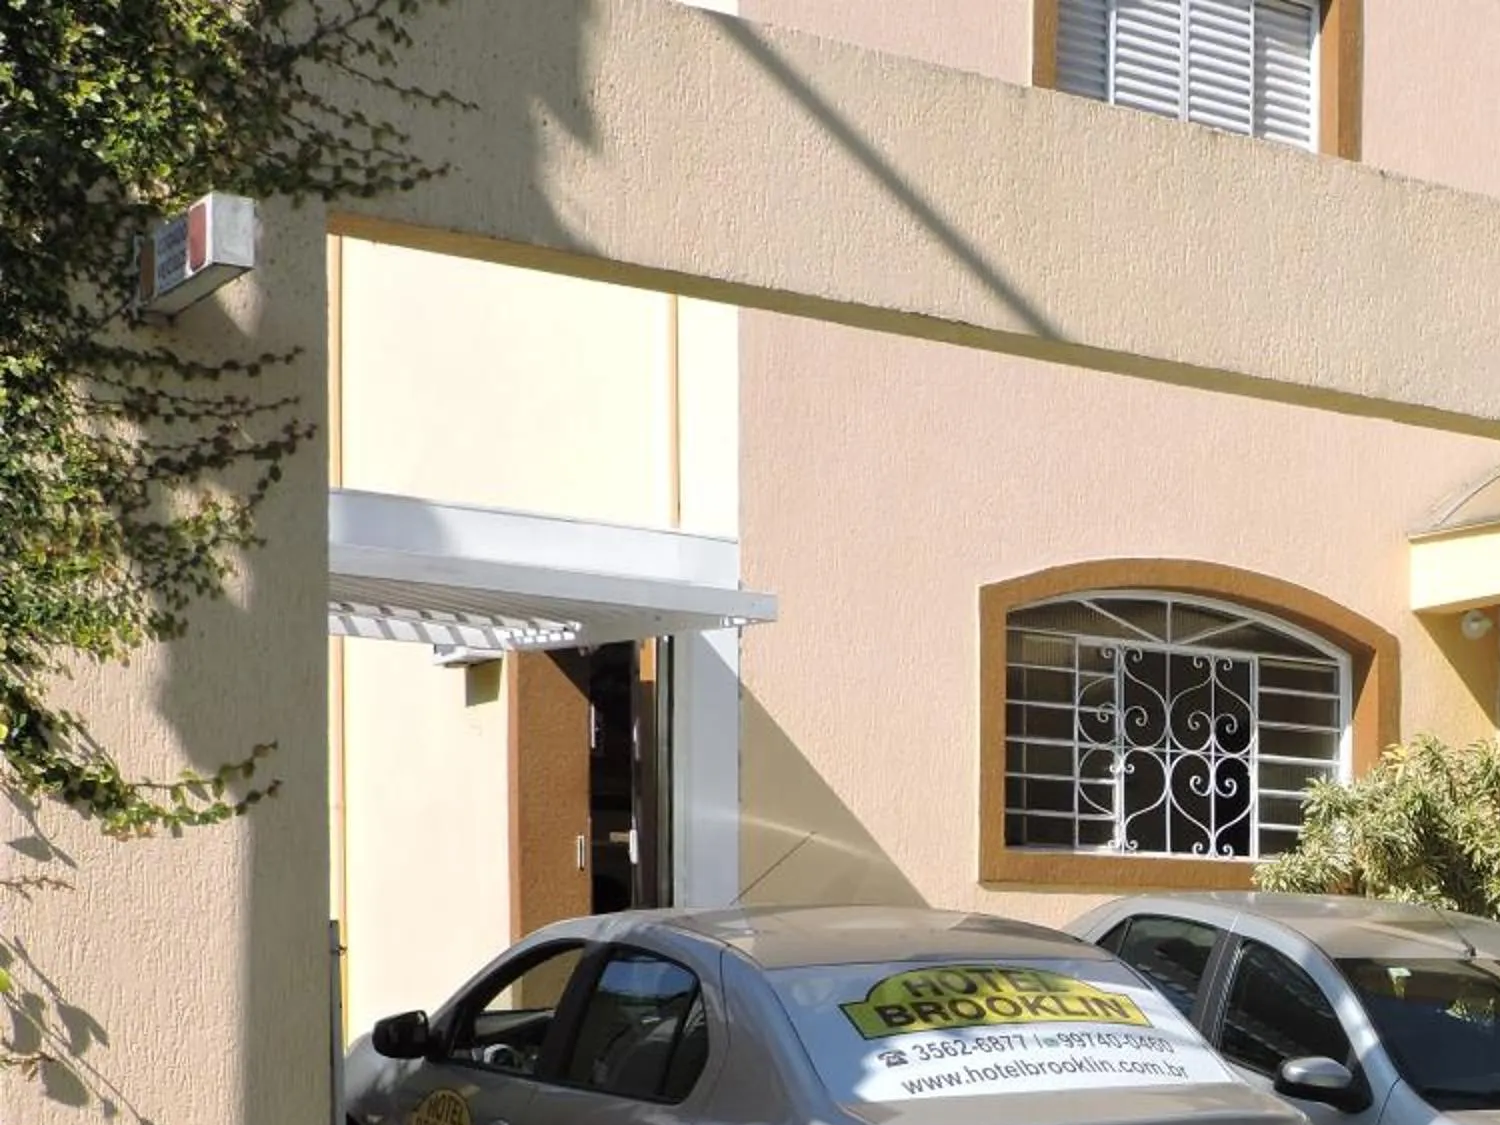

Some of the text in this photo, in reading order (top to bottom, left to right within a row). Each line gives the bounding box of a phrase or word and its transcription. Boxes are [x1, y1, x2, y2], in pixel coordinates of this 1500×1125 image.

[902, 968, 1070, 998] HOTEL
[874, 994, 1131, 1028] BROOKLIN
[911, 1033, 1029, 1062] 3562-6877
[901, 1054, 1189, 1095] www.hotelbrooklin.com.br
